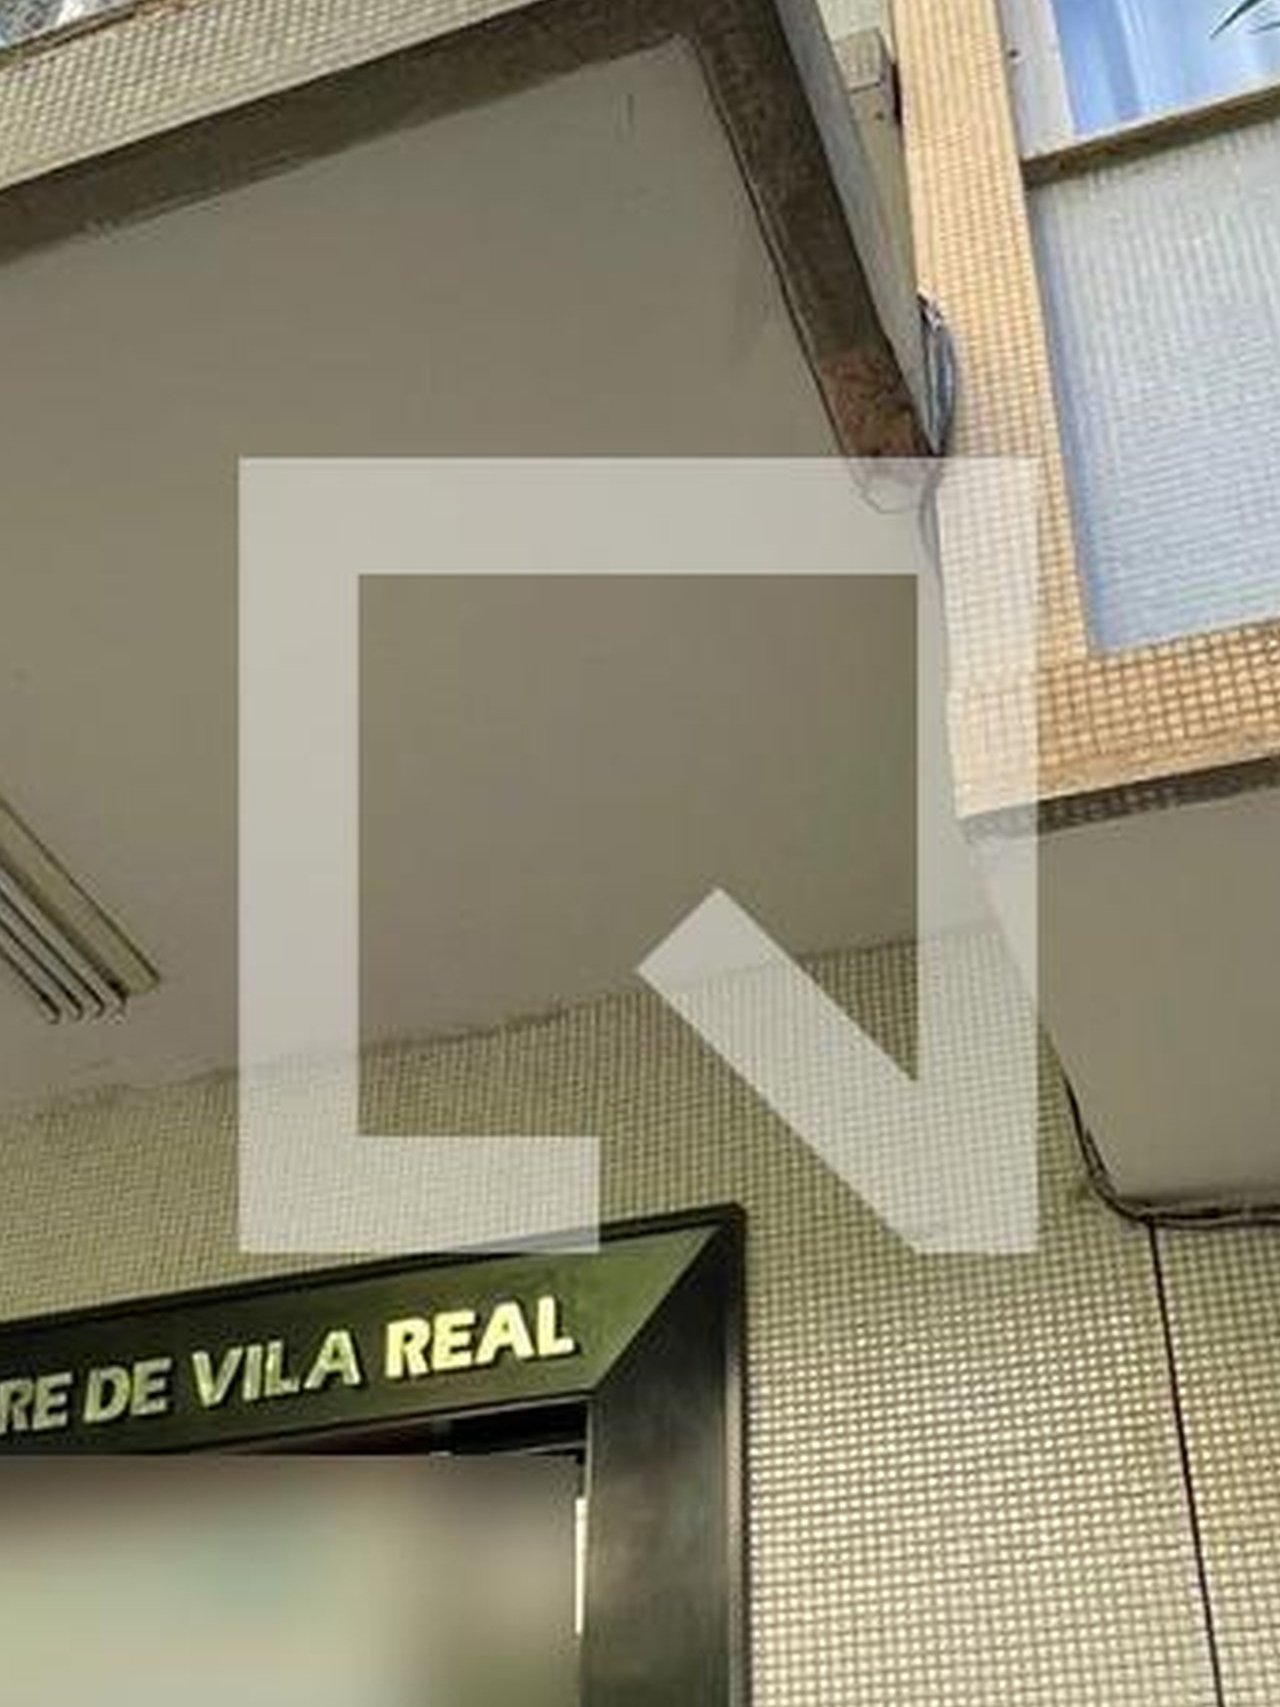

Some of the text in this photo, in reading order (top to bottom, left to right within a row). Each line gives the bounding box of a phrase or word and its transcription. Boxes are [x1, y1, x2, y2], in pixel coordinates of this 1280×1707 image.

[81, 1357, 174, 1425] DE
[190, 1329, 363, 1407] VILA
[383, 1296, 575, 1380] REAL
